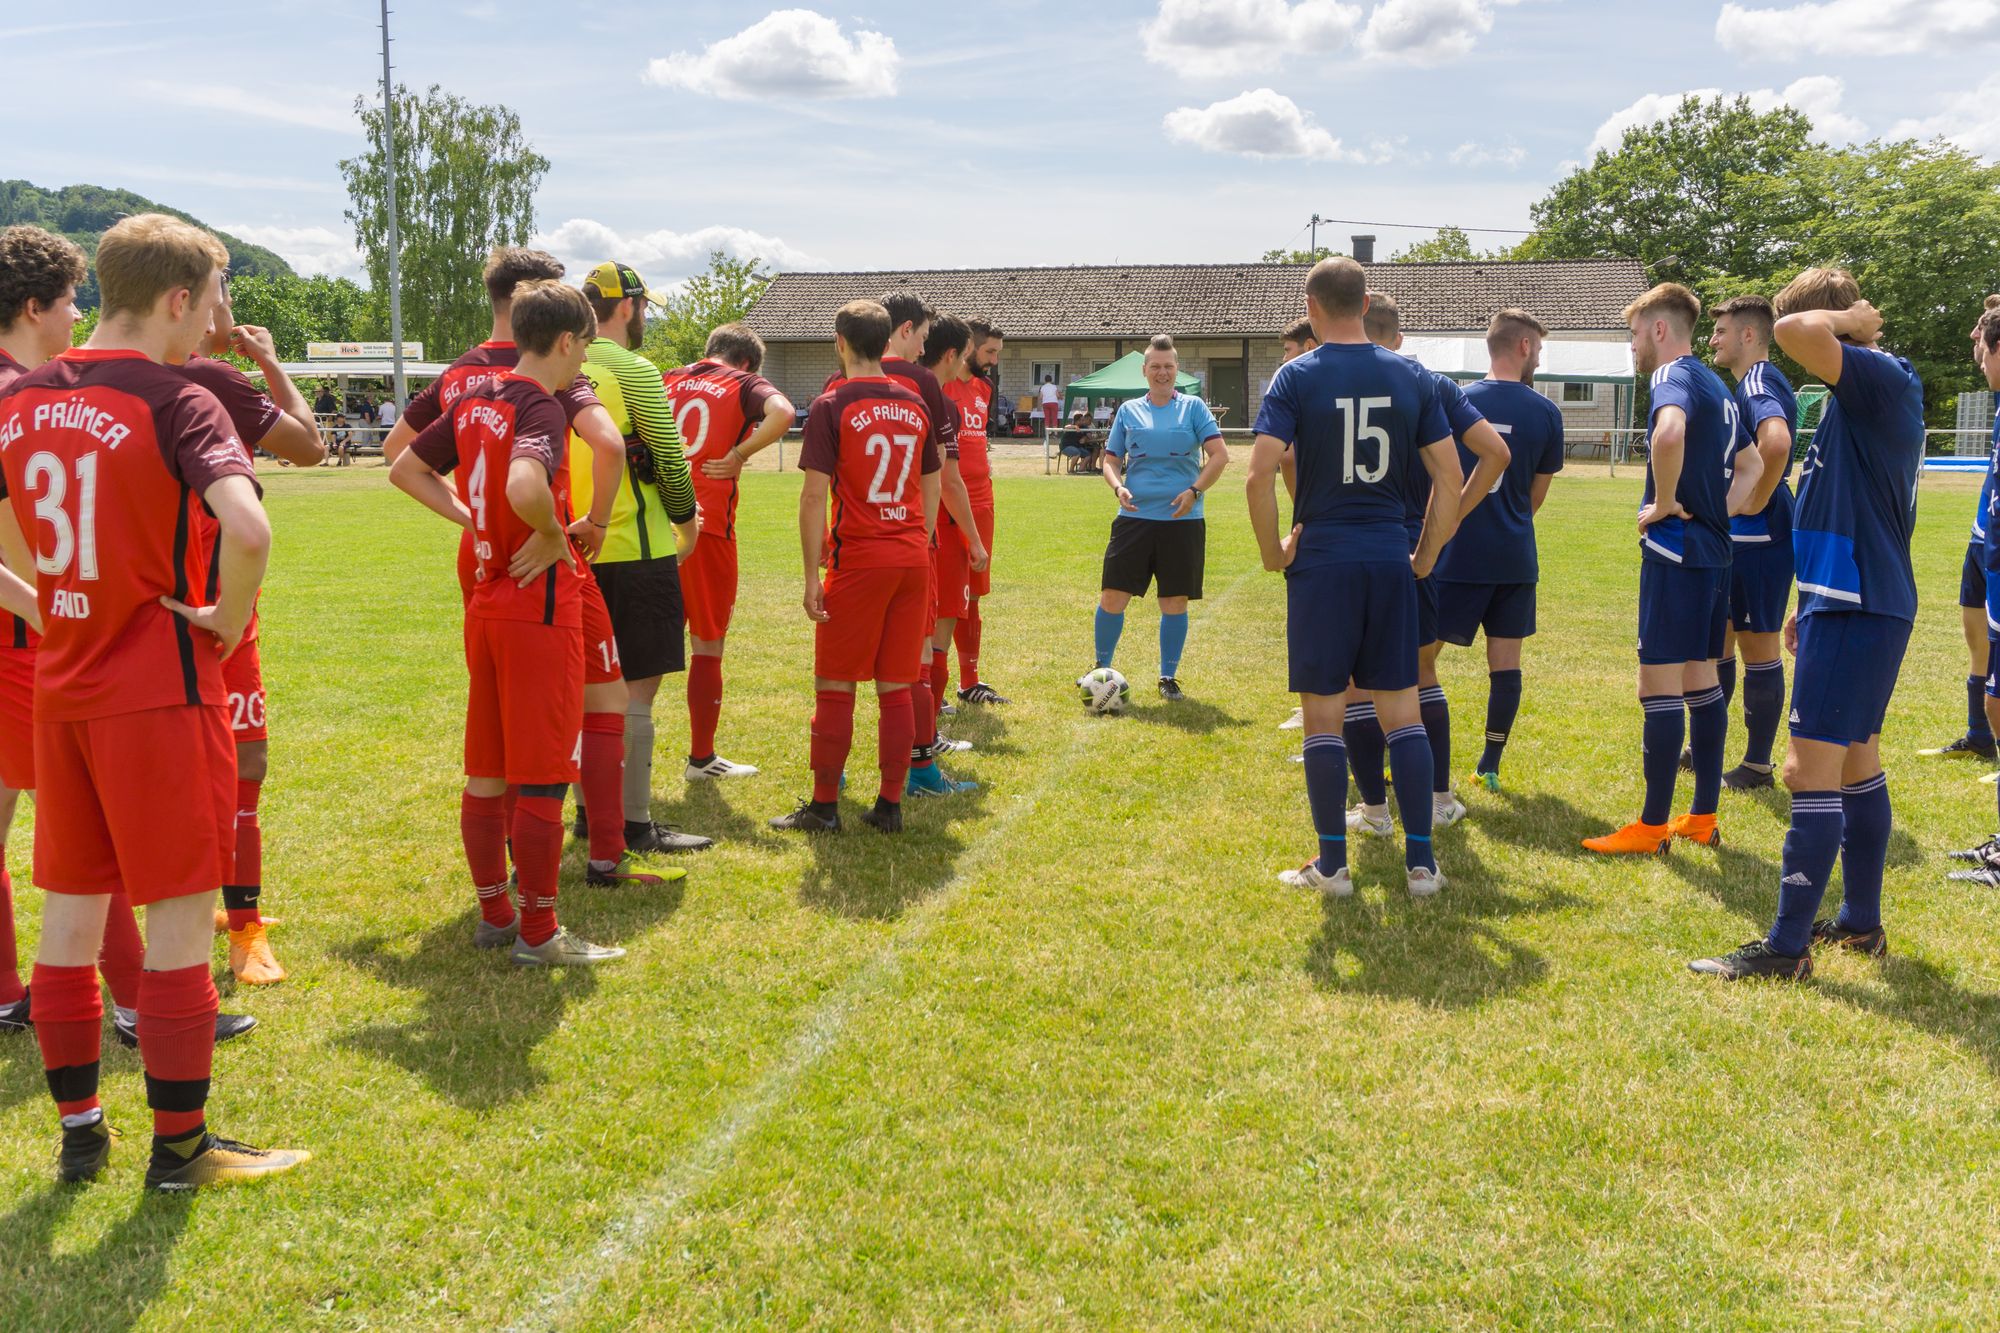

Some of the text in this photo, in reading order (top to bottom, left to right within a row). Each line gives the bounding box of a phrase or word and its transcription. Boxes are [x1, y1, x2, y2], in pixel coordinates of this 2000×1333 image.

[444, 381, 461, 404] SG
[677, 378, 727, 399] PRÜMER
[0, 396, 132, 452] SG PRÜMER
[667, 397, 710, 457] 0
[851, 410, 872, 432] SG
[873, 402, 923, 431] PRÜMER
[1335, 396, 1392, 485] 15
[468, 441, 486, 531] 4
[865, 433, 918, 503] 27
[24, 451, 100, 580] 31
[50, 588, 90, 619] AND
[228, 692, 265, 730] 20
